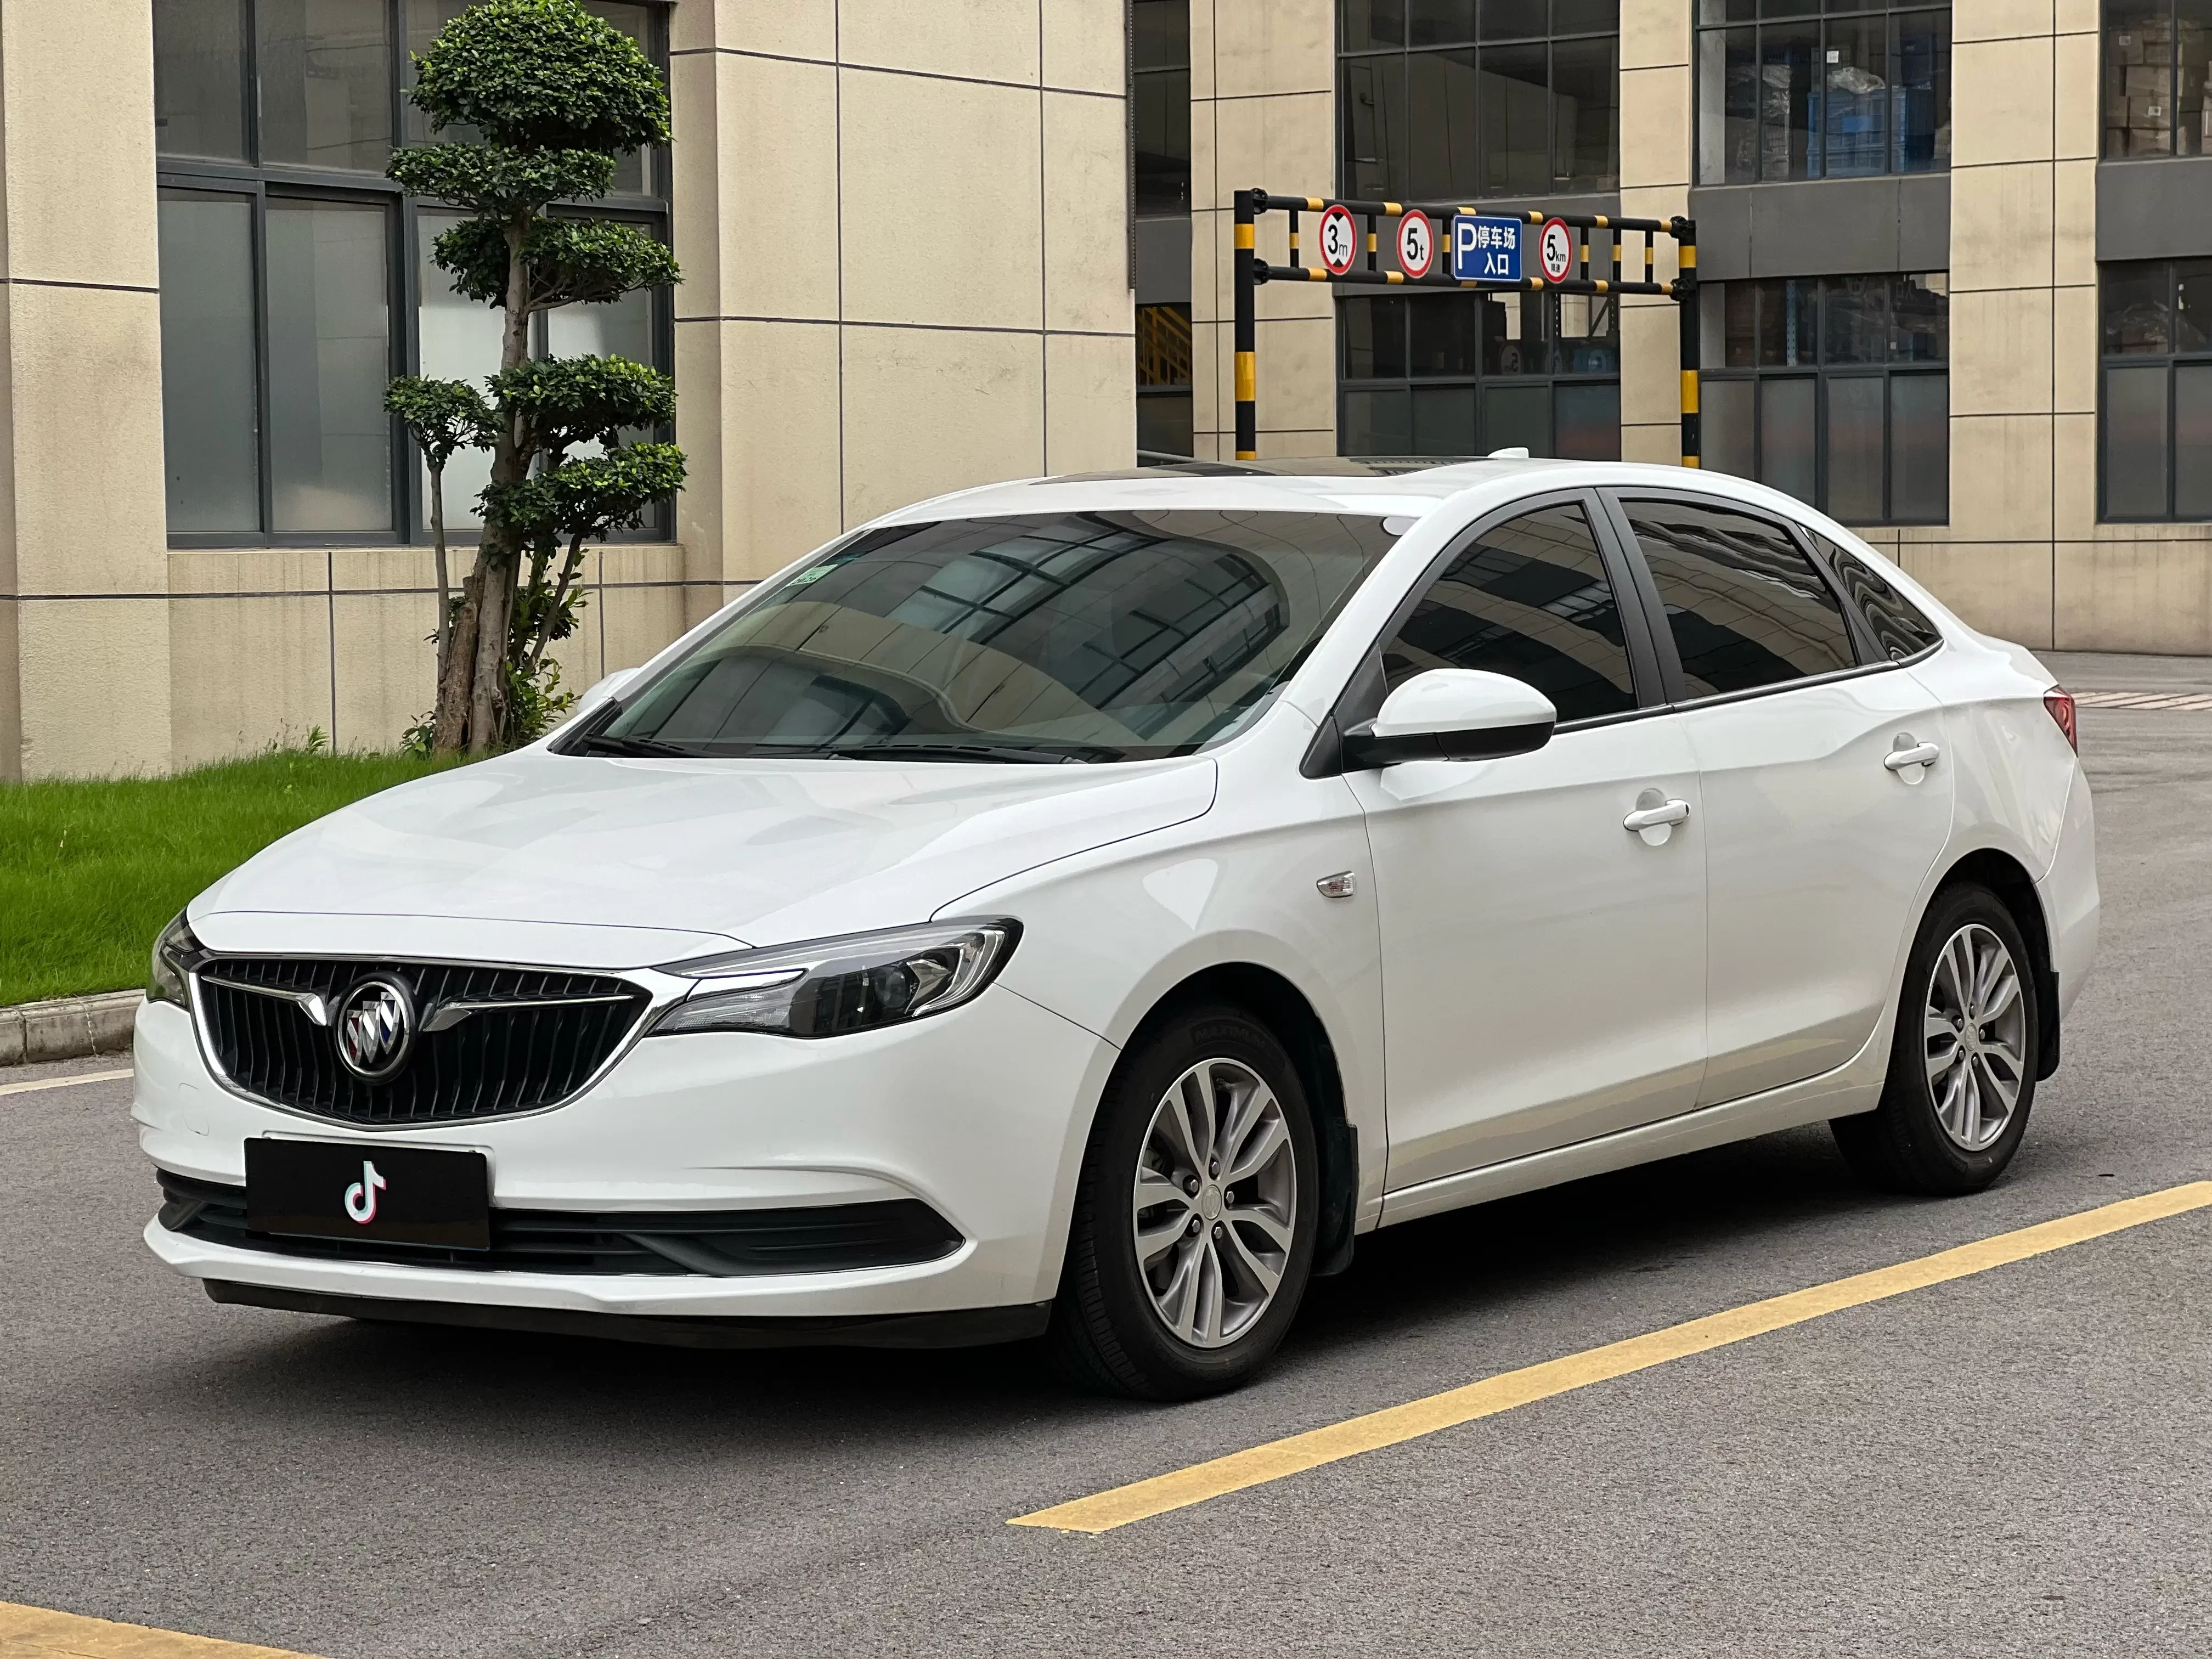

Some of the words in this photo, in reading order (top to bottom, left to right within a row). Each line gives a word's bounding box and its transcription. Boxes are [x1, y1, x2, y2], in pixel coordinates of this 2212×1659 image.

[1328, 224, 1348, 257] 3m
[1407, 228, 1424, 261] 5t
[1477, 225, 1515, 250] 停车场
[1547, 234, 1566, 262] 5km
[1483, 252, 1509, 275] 入口
